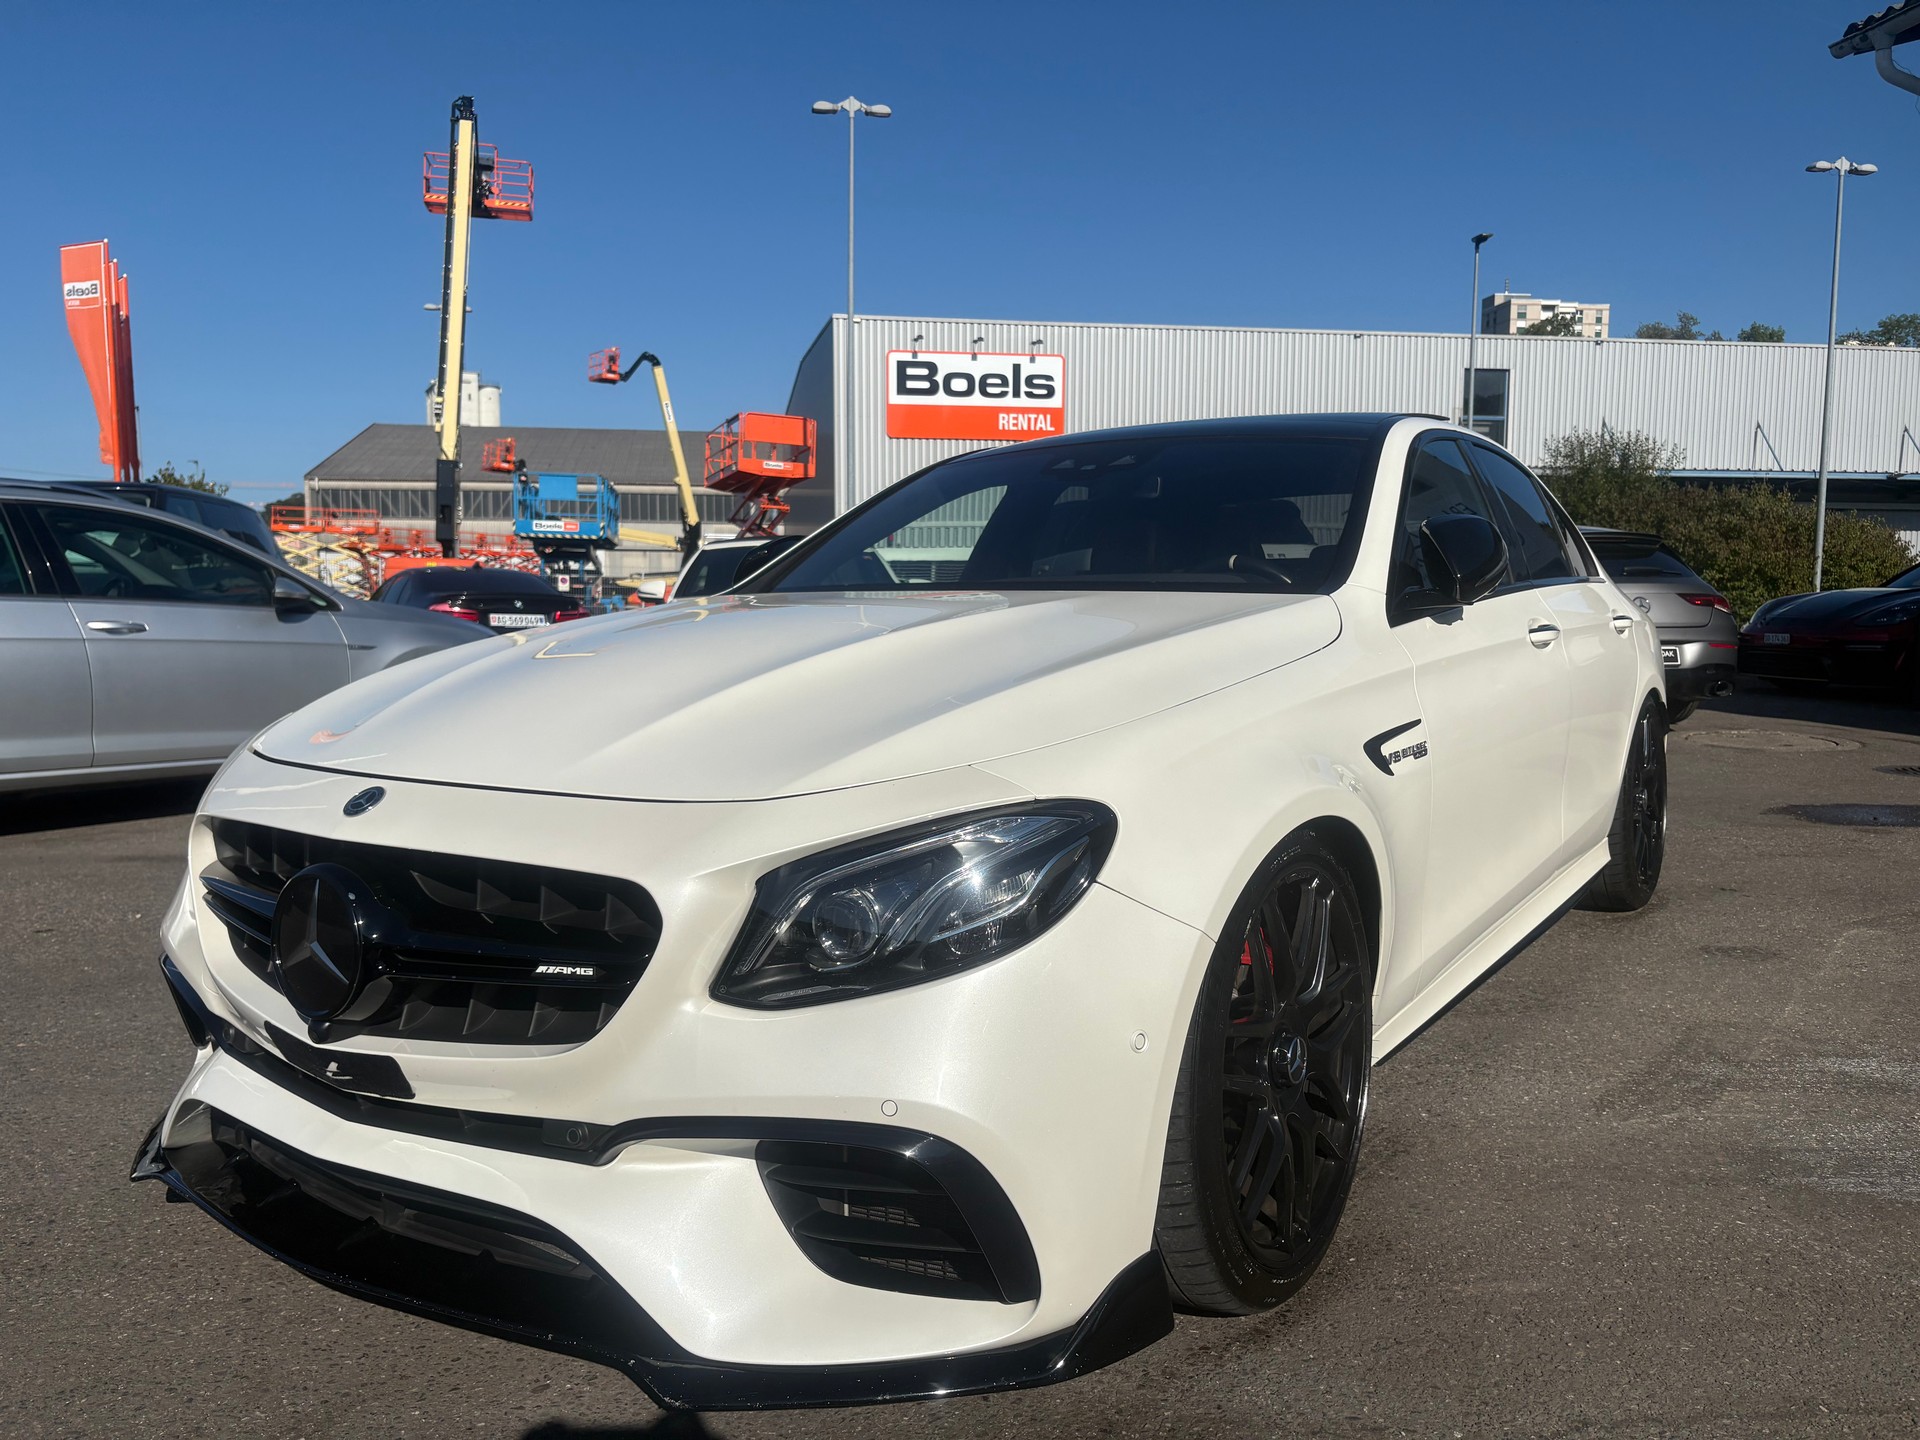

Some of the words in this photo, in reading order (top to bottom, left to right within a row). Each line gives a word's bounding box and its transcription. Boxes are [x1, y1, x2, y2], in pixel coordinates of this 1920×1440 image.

[896, 360, 1056, 400] Boels
[998, 413, 1055, 431] RENTAL
[1384, 750, 1401, 765] V8
[553, 966, 594, 976] AMG
